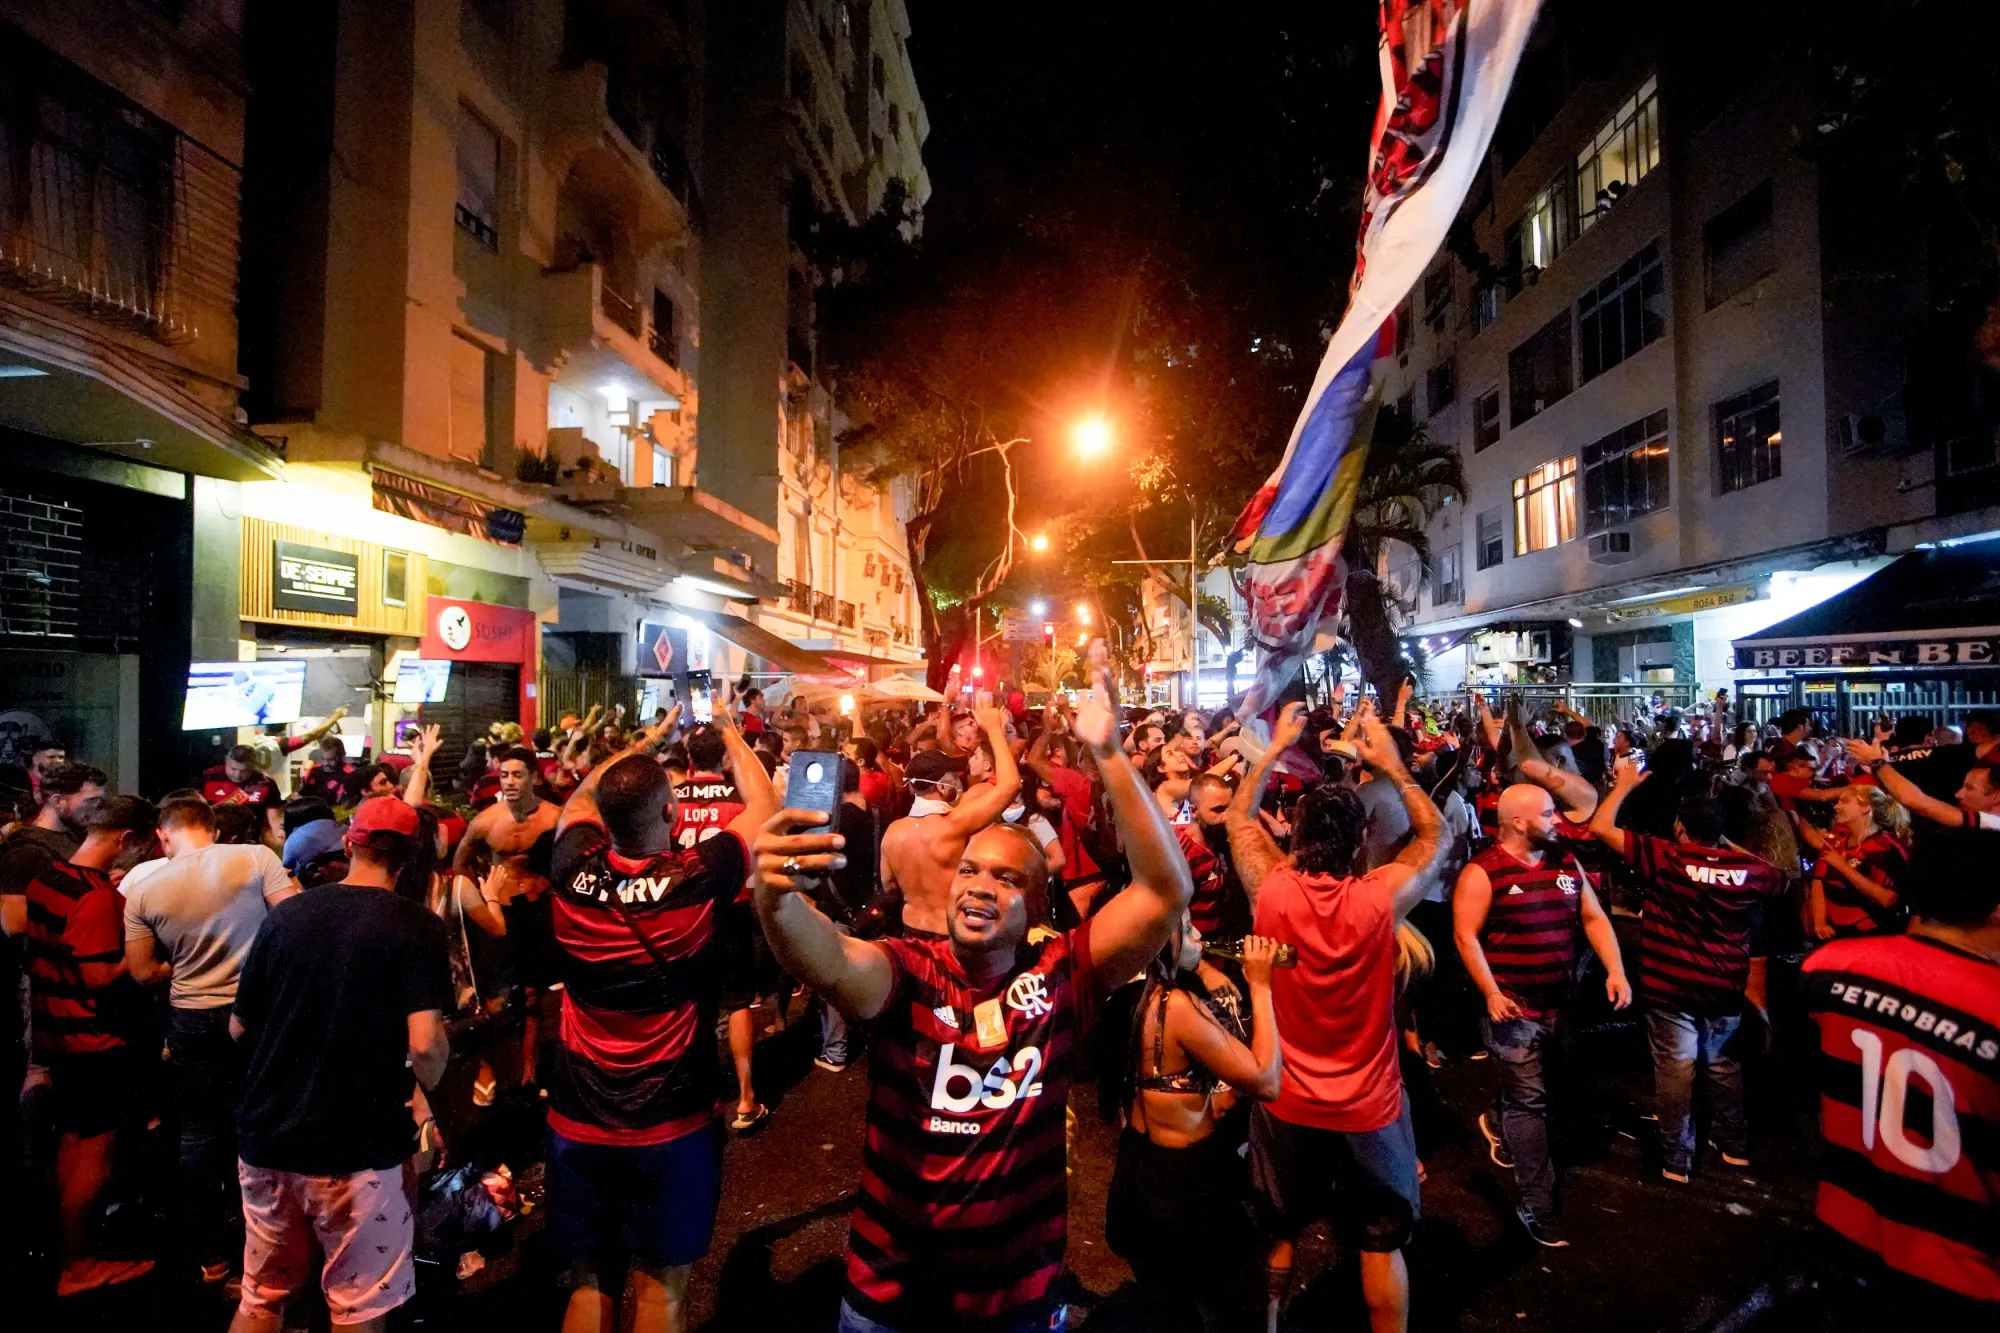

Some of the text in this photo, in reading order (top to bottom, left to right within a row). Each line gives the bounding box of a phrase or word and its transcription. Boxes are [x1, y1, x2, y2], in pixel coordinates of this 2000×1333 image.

[1753, 646, 1855, 668] BEEF
[1917, 641, 2000, 664] BE
[692, 784, 735, 799] MRV
[684, 807, 719, 823] LOP'S
[1685, 864, 1748, 886] MRV
[1831, 982, 2000, 1060] PETROBRAS
[930, 1043, 1043, 1113] bs2
[1851, 1027, 1962, 1174] 10
[929, 1115, 981, 1136] Banco
